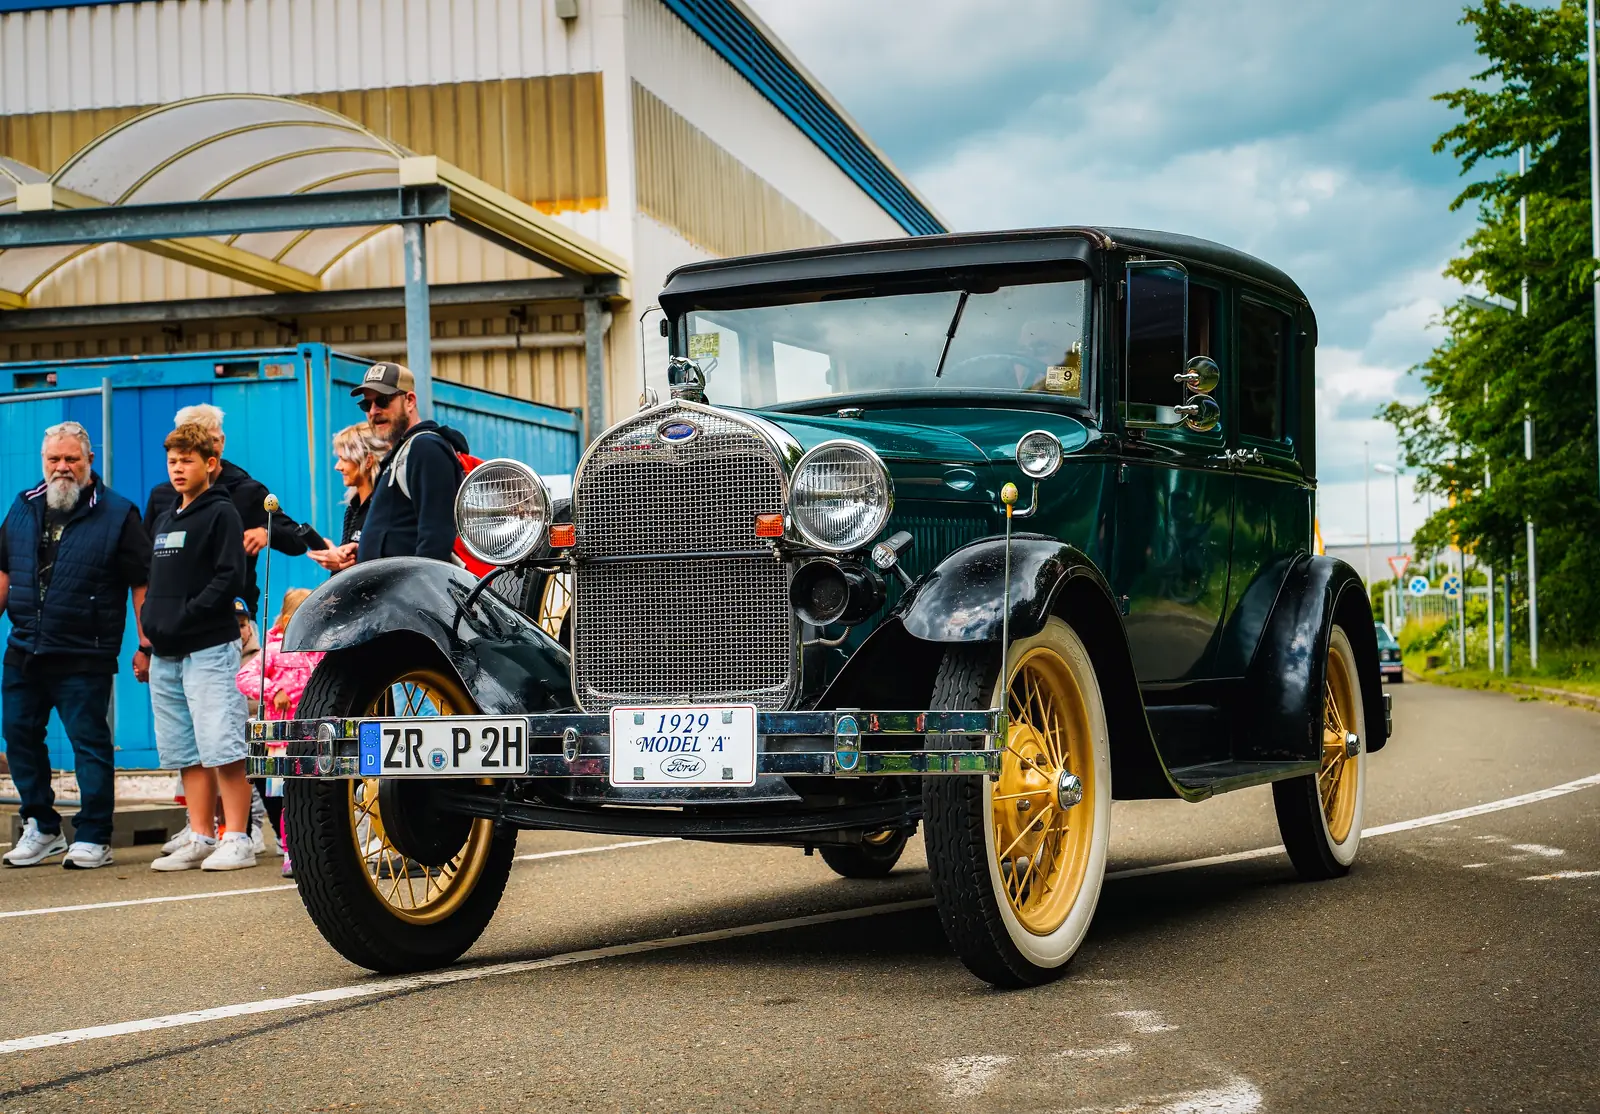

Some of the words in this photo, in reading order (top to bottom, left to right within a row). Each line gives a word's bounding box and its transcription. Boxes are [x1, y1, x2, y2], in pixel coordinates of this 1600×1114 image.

[1063, 370, 1072, 381] 9
[657, 713, 709, 734] 1929
[383, 728, 424, 768] ZR
[451, 727, 471, 767] P
[481, 726, 522, 767] 2H
[636, 736, 701, 753] MODEL
[367, 754, 375, 766] D
[667, 758, 700, 772] Ford
